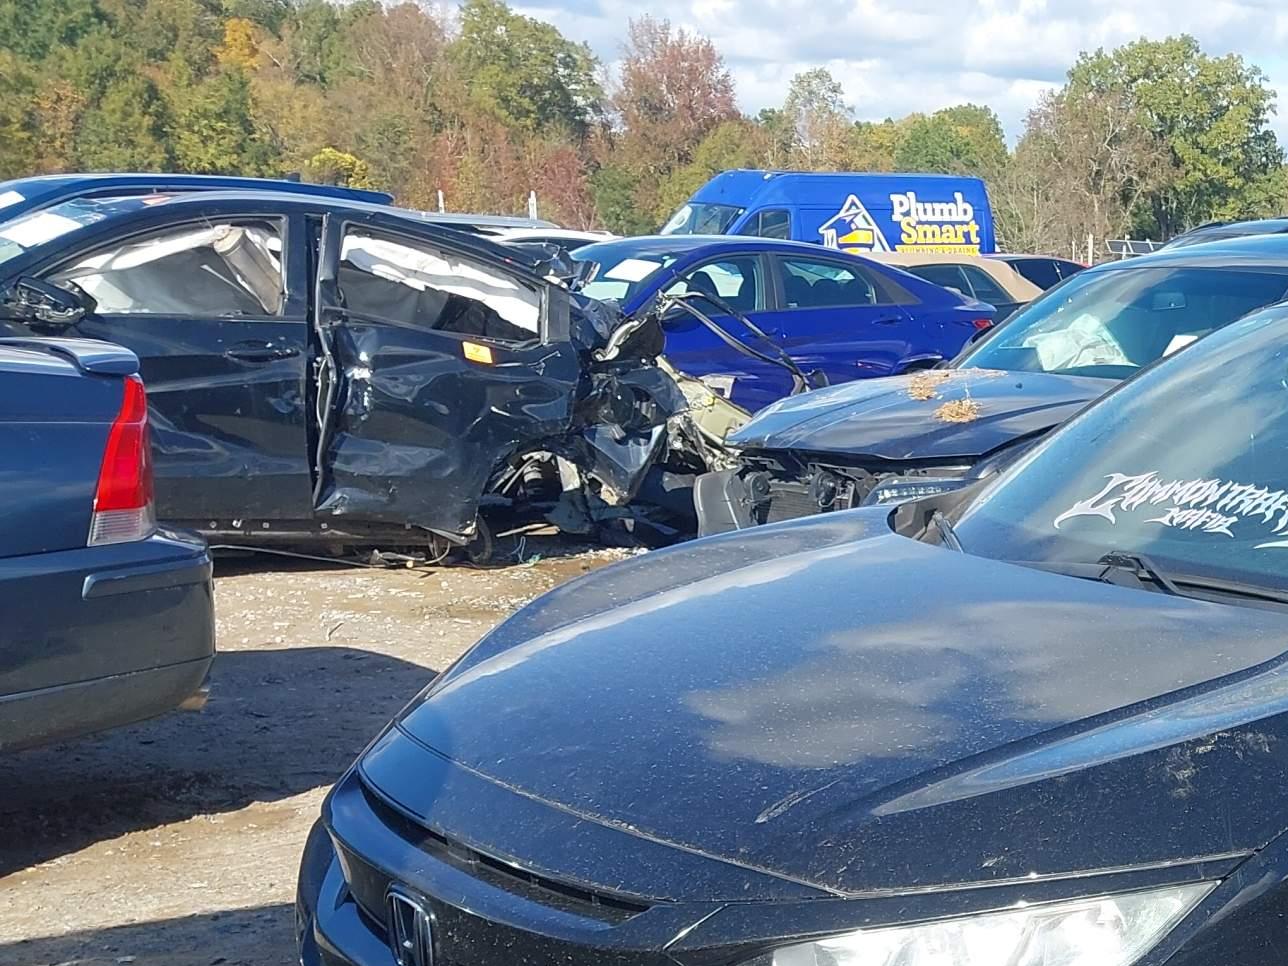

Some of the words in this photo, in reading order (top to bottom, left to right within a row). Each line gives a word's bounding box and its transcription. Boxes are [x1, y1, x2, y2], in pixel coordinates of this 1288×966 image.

[890, 191, 974, 221] Plumb
[901, 216, 980, 244] Smart
[1144, 507, 1239, 538] MAFIA
